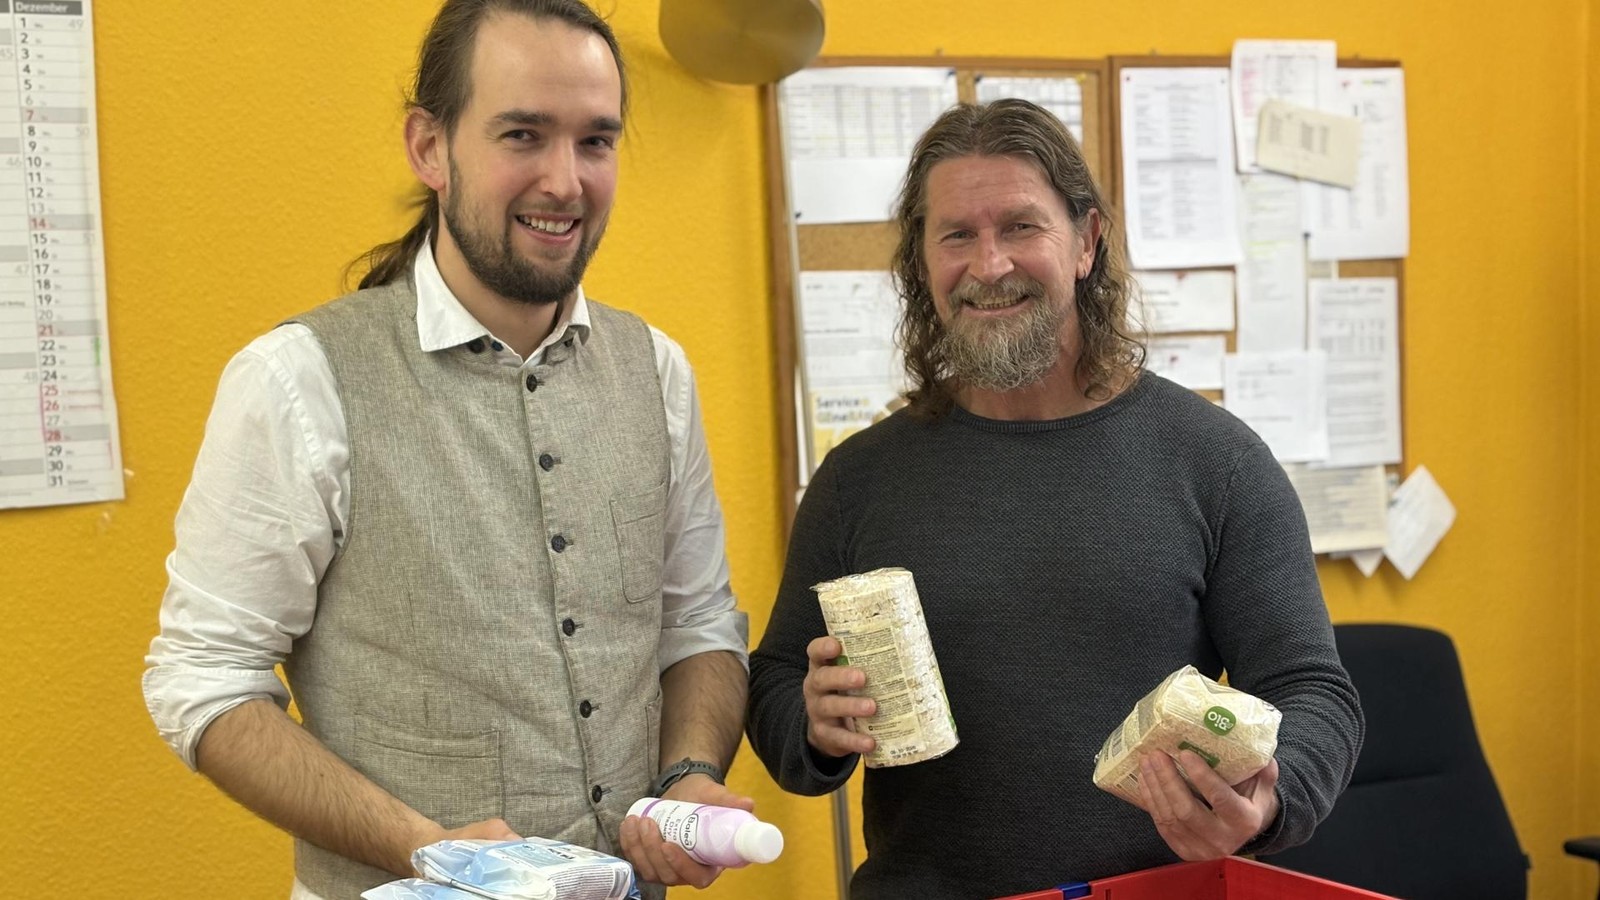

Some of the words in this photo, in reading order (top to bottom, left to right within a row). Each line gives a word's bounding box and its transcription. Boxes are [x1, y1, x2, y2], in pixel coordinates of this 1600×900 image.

[15, 2, 68, 13] Dezember
[20, 17, 26, 28] 1
[68, 18, 84, 29] 49
[20, 32, 28, 44] 2
[21, 48, 30, 60] 3
[22, 64, 31, 74] 4
[24, 79, 32, 90] 5
[25, 95, 34, 106] 6
[26, 109, 34, 121] 7
[27, 125, 36, 137] 8
[28, 140, 37, 152] 9
[27, 156, 42, 167] 10
[28, 171, 41, 183] 11
[29, 187, 44, 199] 12
[30, 202, 45, 214] 13
[31, 217, 46, 229] 14
[33, 233, 48, 244] 15
[34, 248, 49, 259] 16
[35, 263, 50, 274] 17
[36, 279, 51, 290] 18
[37, 294, 52, 306] 19
[39, 309, 53, 320] 20
[39, 324, 53, 336] 21
[41, 339, 56, 351] 22
[42, 354, 57, 366] 23
[43, 370, 57, 381] 24
[44, 385, 58, 397] 25
[44, 400, 60, 411] 26
[816, 395, 859, 409] Service
[46, 415, 60, 427] 27
[47, 430, 62, 442] 28
[48, 445, 63, 457] 29
[48, 460, 64, 472] 30
[49, 475, 63, 487] 31
[1207, 711, 1230, 730] Bio
[673, 819, 681, 841] Extra
